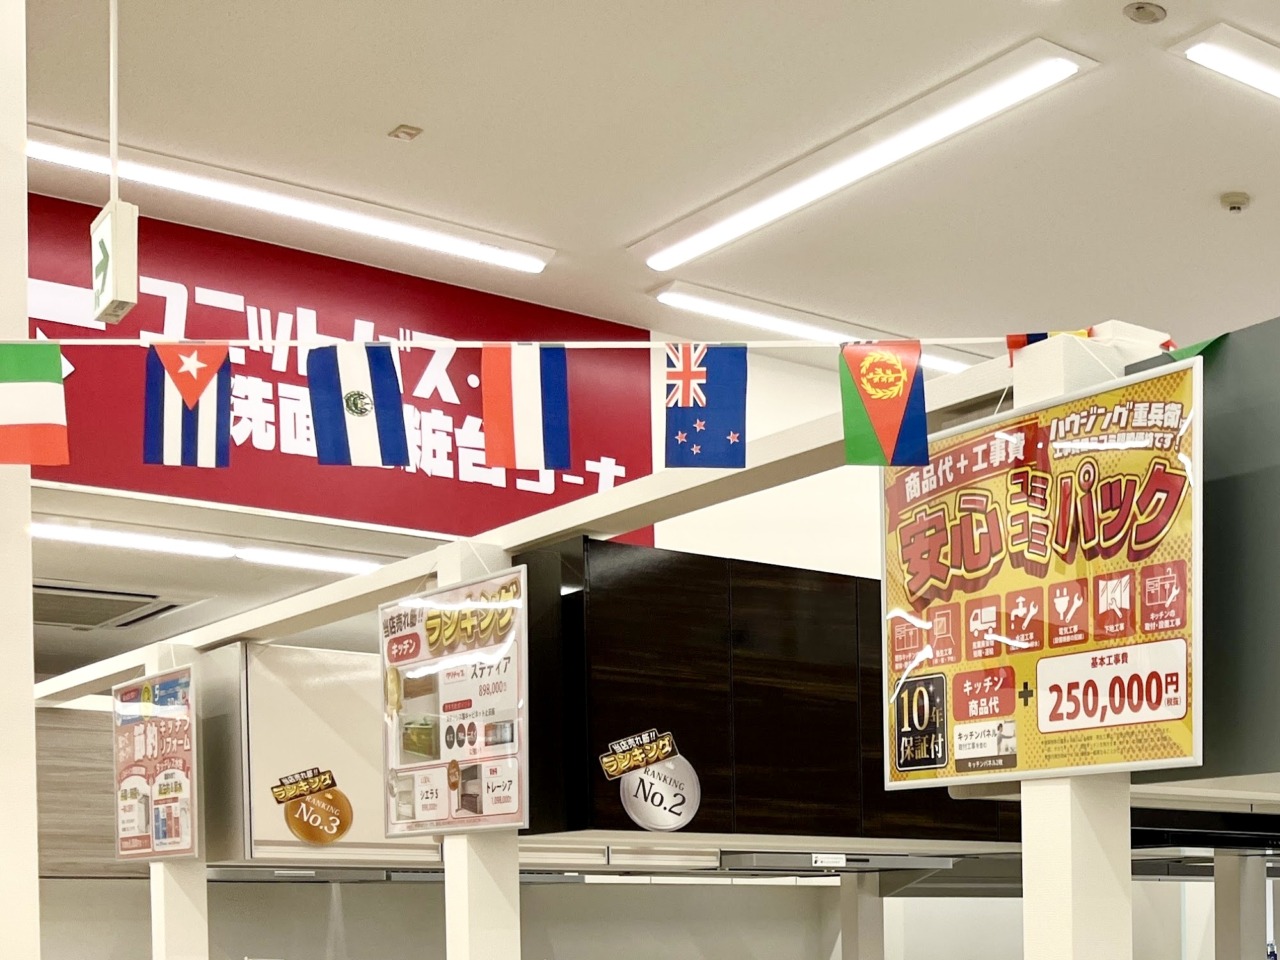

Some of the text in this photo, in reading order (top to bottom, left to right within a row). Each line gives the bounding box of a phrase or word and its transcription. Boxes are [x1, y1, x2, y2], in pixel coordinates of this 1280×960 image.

[426, 581, 517, 645] ランキング
[391, 639, 416, 658] キッチン
[1091, 652, 1128, 668] 基本工事費
[963, 675, 1003, 696] キッチン
[1049, 670, 1180, 722] 250,000円
[968, 696, 999, 716] 商品代
[958, 728, 998, 741] キッチンパネル
[602, 736, 672, 775] ランキング
[900, 736, 943, 763] 保証付
[273, 773, 333, 801] ランキング
[644, 766, 685, 791] RANKING
[305, 795, 340, 816] RANKING
[633, 777, 686, 817] No.2
[294, 803, 340, 834] No.3
